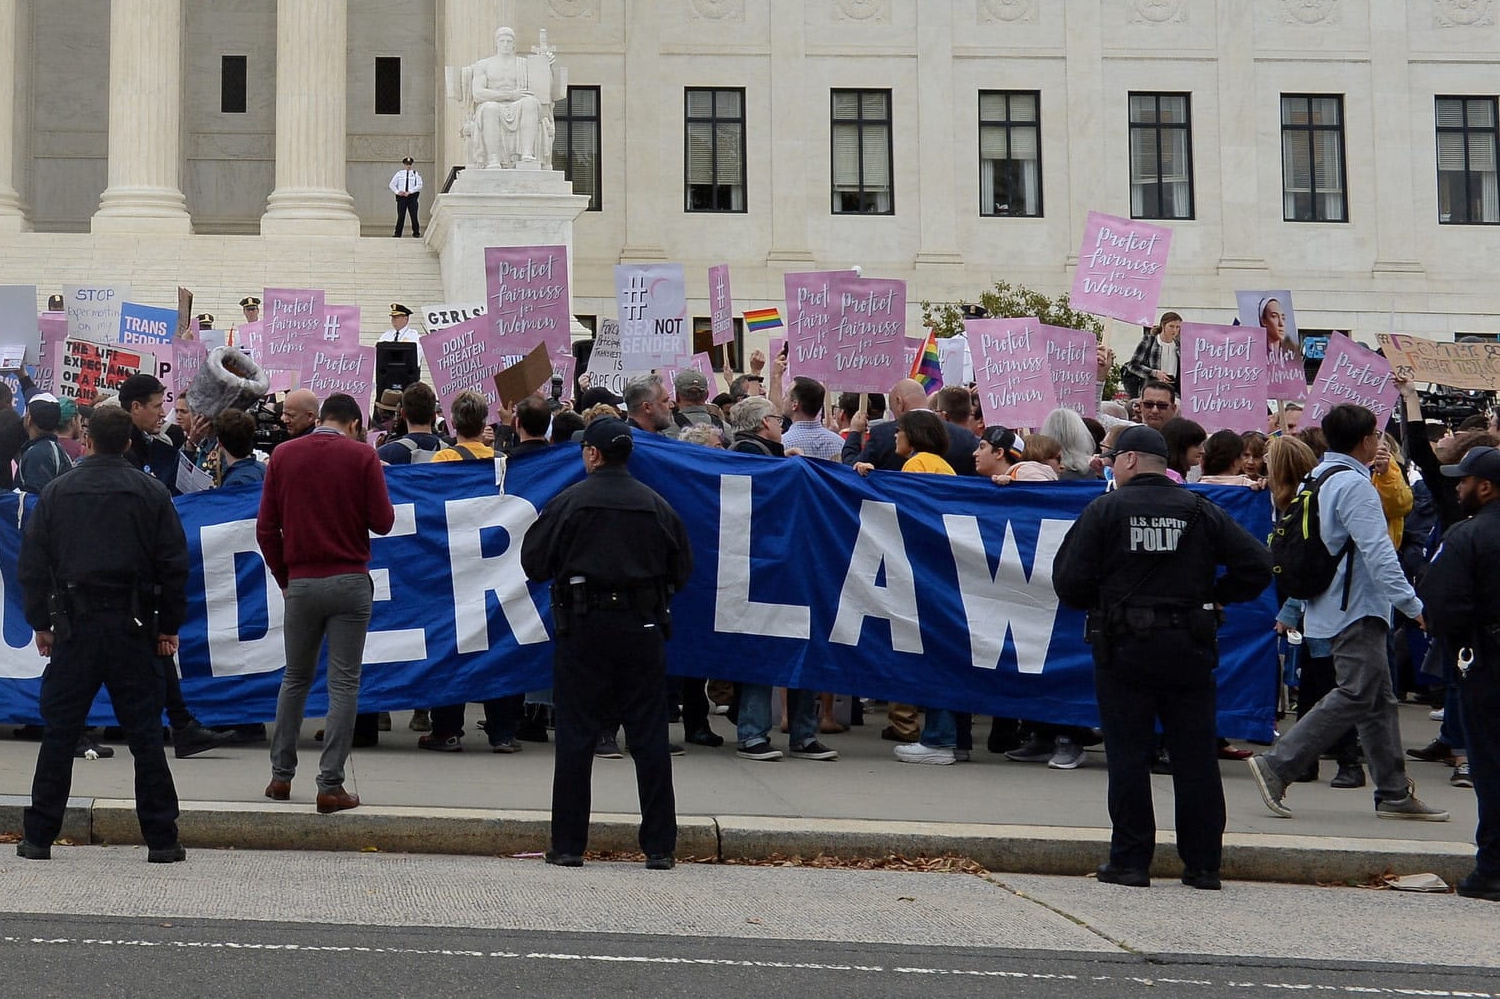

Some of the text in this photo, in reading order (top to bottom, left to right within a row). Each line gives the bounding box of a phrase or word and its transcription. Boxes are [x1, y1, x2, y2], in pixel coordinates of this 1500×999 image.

[75, 289, 114, 301] STOP
[124, 316, 168, 336] TRANS
[654, 319, 683, 335] NOT
[66, 341, 119, 359] THE LIFE
[442, 330, 475, 354] DON'T
[437, 340, 486, 370] THREATEN
[450, 356, 485, 381] EQUAL
[613, 360, 623, 371] IS
[94, 377, 122, 391] BLAC
[440, 363, 500, 396] OPPORTUNITY
[60, 385, 96, 400] TRANS
[1130, 516, 1149, 527] U.S.
[1130, 527, 1183, 551] POLIC
[713, 473, 1077, 675] LAW
